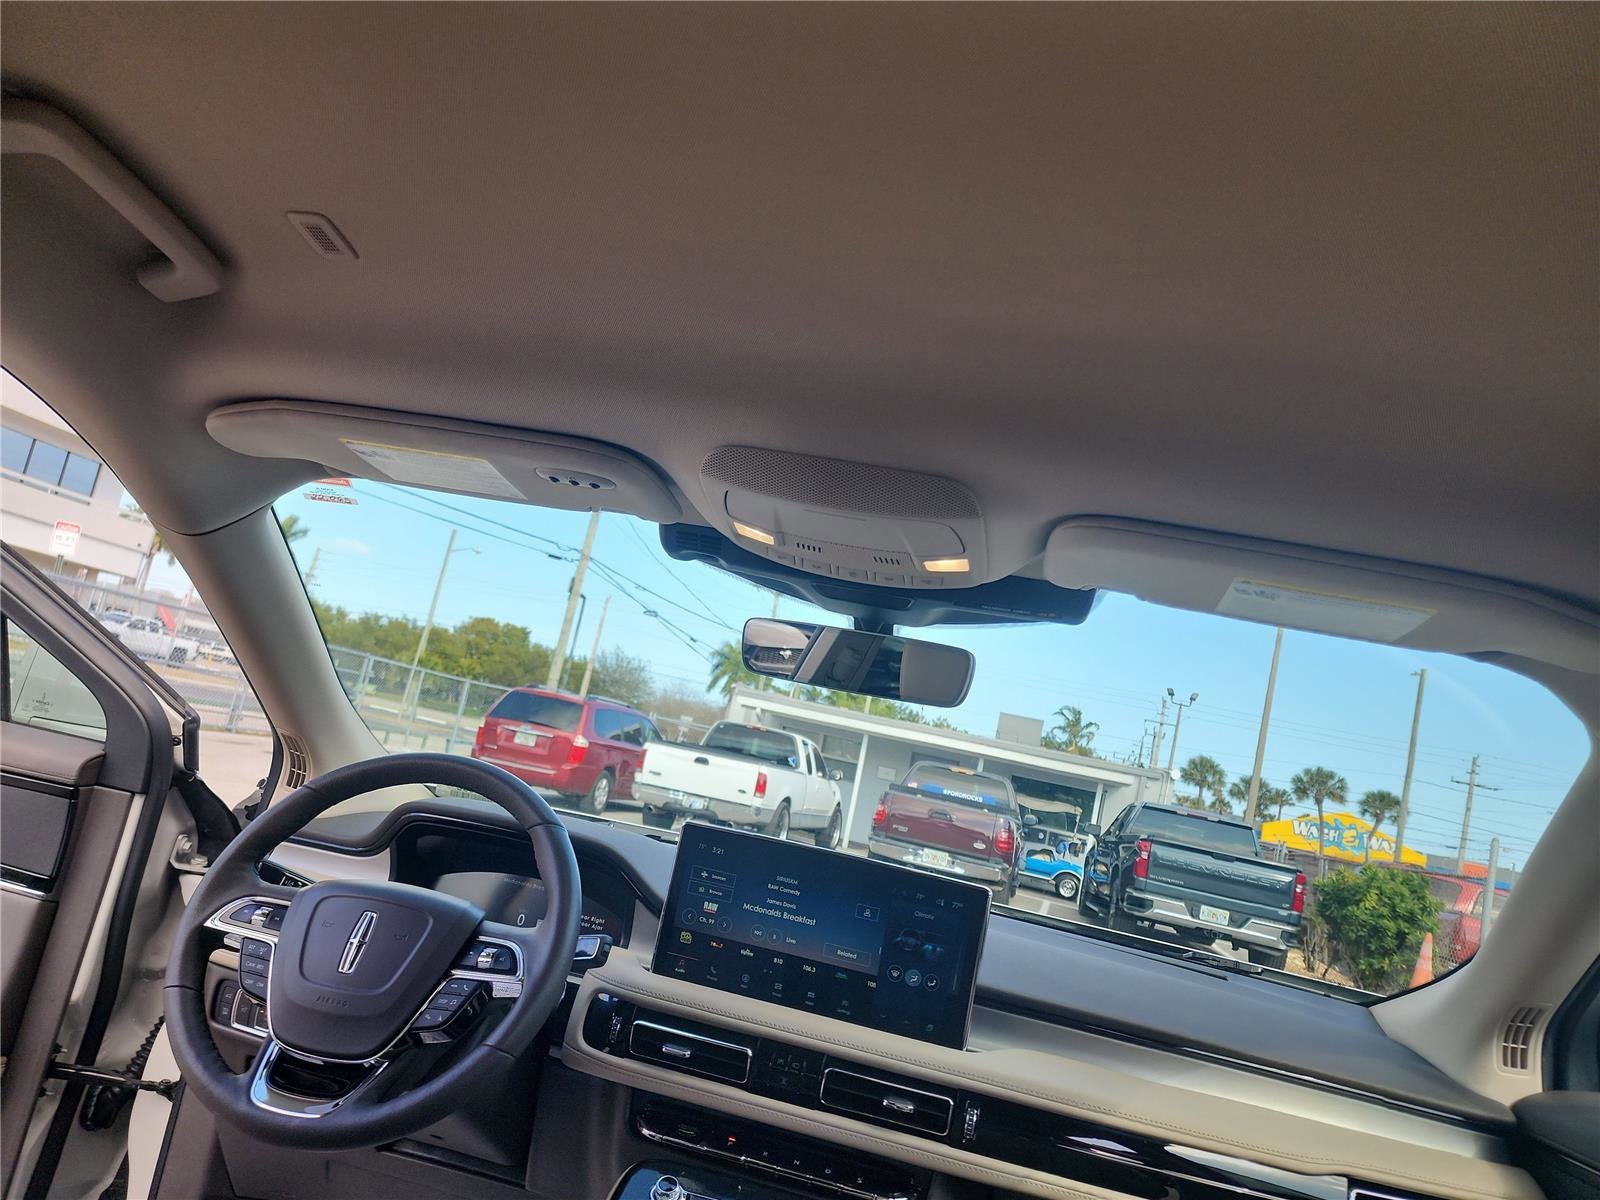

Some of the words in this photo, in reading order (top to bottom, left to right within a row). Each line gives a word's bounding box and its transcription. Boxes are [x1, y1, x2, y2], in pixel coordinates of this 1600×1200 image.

[1292, 820, 1339, 842] WASH
[779, 887, 801, 896] Comedy
[766, 897, 782, 906] James
[782, 901, 797, 910] Davis
[517, 913, 526, 926] 0
[591, 914, 606, 925] Right
[742, 902, 782, 918] Mcdonalds
[783, 912, 817, 926] Breakfast
[591, 923, 604, 932] Ajar
[786, 936, 797, 944] Live
[836, 949, 858, 960] Related
